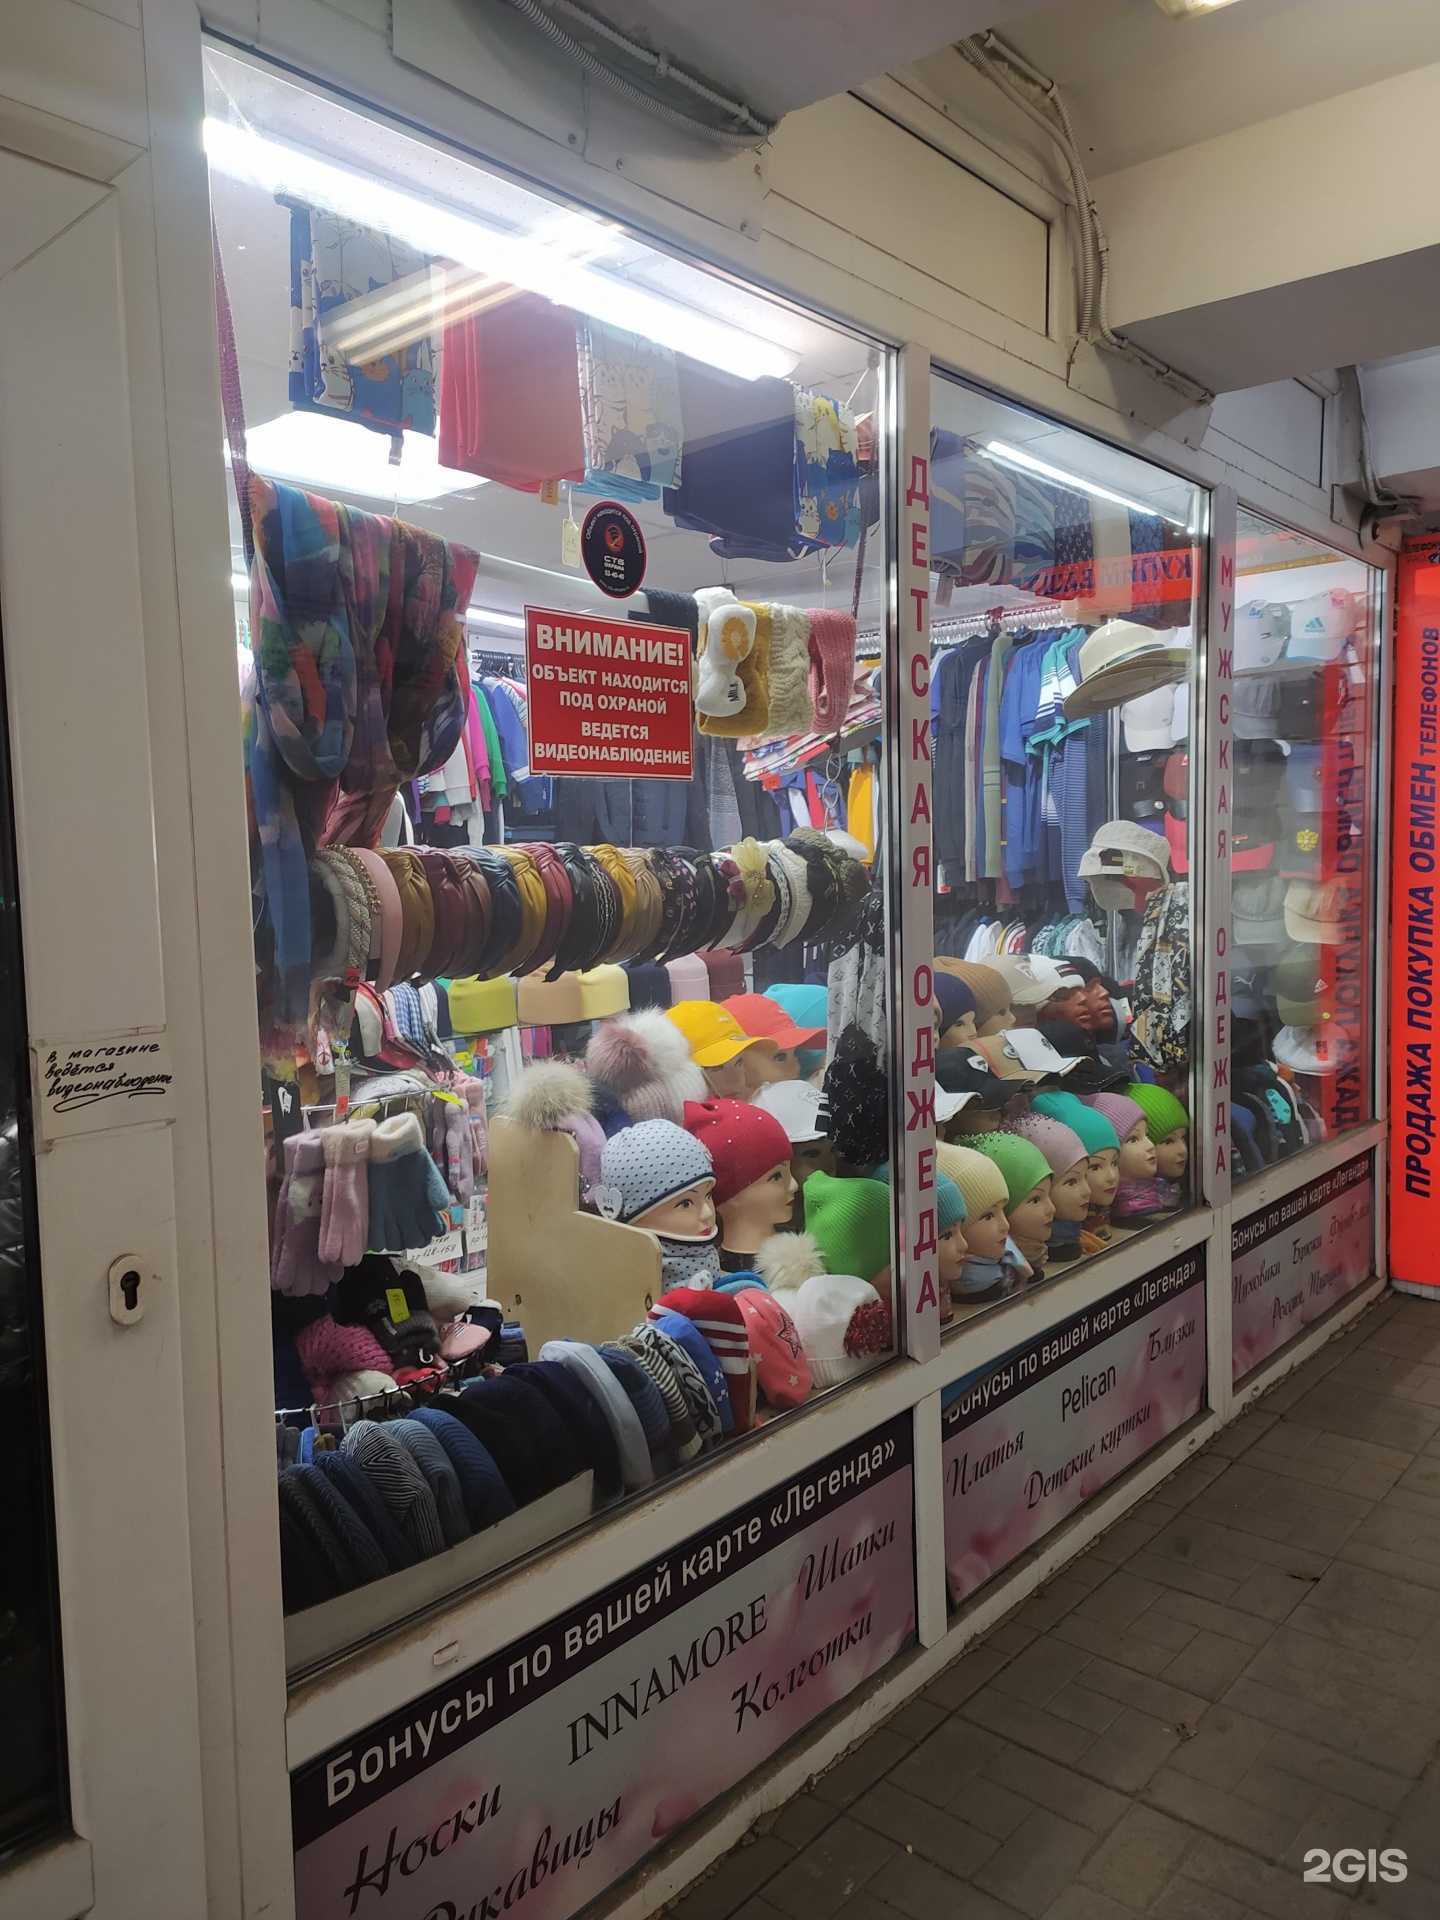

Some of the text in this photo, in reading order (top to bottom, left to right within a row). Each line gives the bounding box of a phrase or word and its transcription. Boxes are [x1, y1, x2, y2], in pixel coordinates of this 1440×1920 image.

[532, 664, 688, 694] ОБЪЕКТ НАХОДИТСЯ
[536, 623, 684, 666] ВНИМАНИЕ!
[560, 691, 667, 714] ПОД ОХРАНОЙ
[581, 721, 649, 740] ВЕДЕТСЯ
[534, 742, 690, 765] ВИДЕОНАБЛЮДЕНИЕ
[906, 456, 938, 1315] ДЕТСКАЯ ОДЖЕДА
[1214, 555, 1233, 1175] МУЖСКАЯ ОДЕЖДА
[1405, 627, 1440, 1198] ПРОДАЖА ПОКУПКА ОБМЕН ТЕЛЕФОНОВ
[1232, 1220, 1267, 1251] Бонусы
[1268, 1212, 1279, 1231] по
[1281, 1192, 1308, 1220] вашей
[1309, 1181, 1331, 1208] карте
[1019, 1353, 1038, 1380] по
[1042, 1317, 1090, 1366] вашей
[1093, 1300, 1131, 1335] карте
[1134, 1259, 1196, 1310] «Легенда»
[1061, 1365, 1117, 1423] Pelican
[946, 1430, 1025, 1497] Платья
[1024, 1443, 1096, 1510] Детские
[795, 1517, 897, 1601] Шапки
[326, 1437, 896, 1808] Бонусы по вашей карте «Легенда»
[566, 1593, 769, 1766] INNAMORE
[730, 1610, 874, 1735] Колготки
[343, 1783, 503, 1916] Носки
[423, 1795, 624, 1920] укавицы
